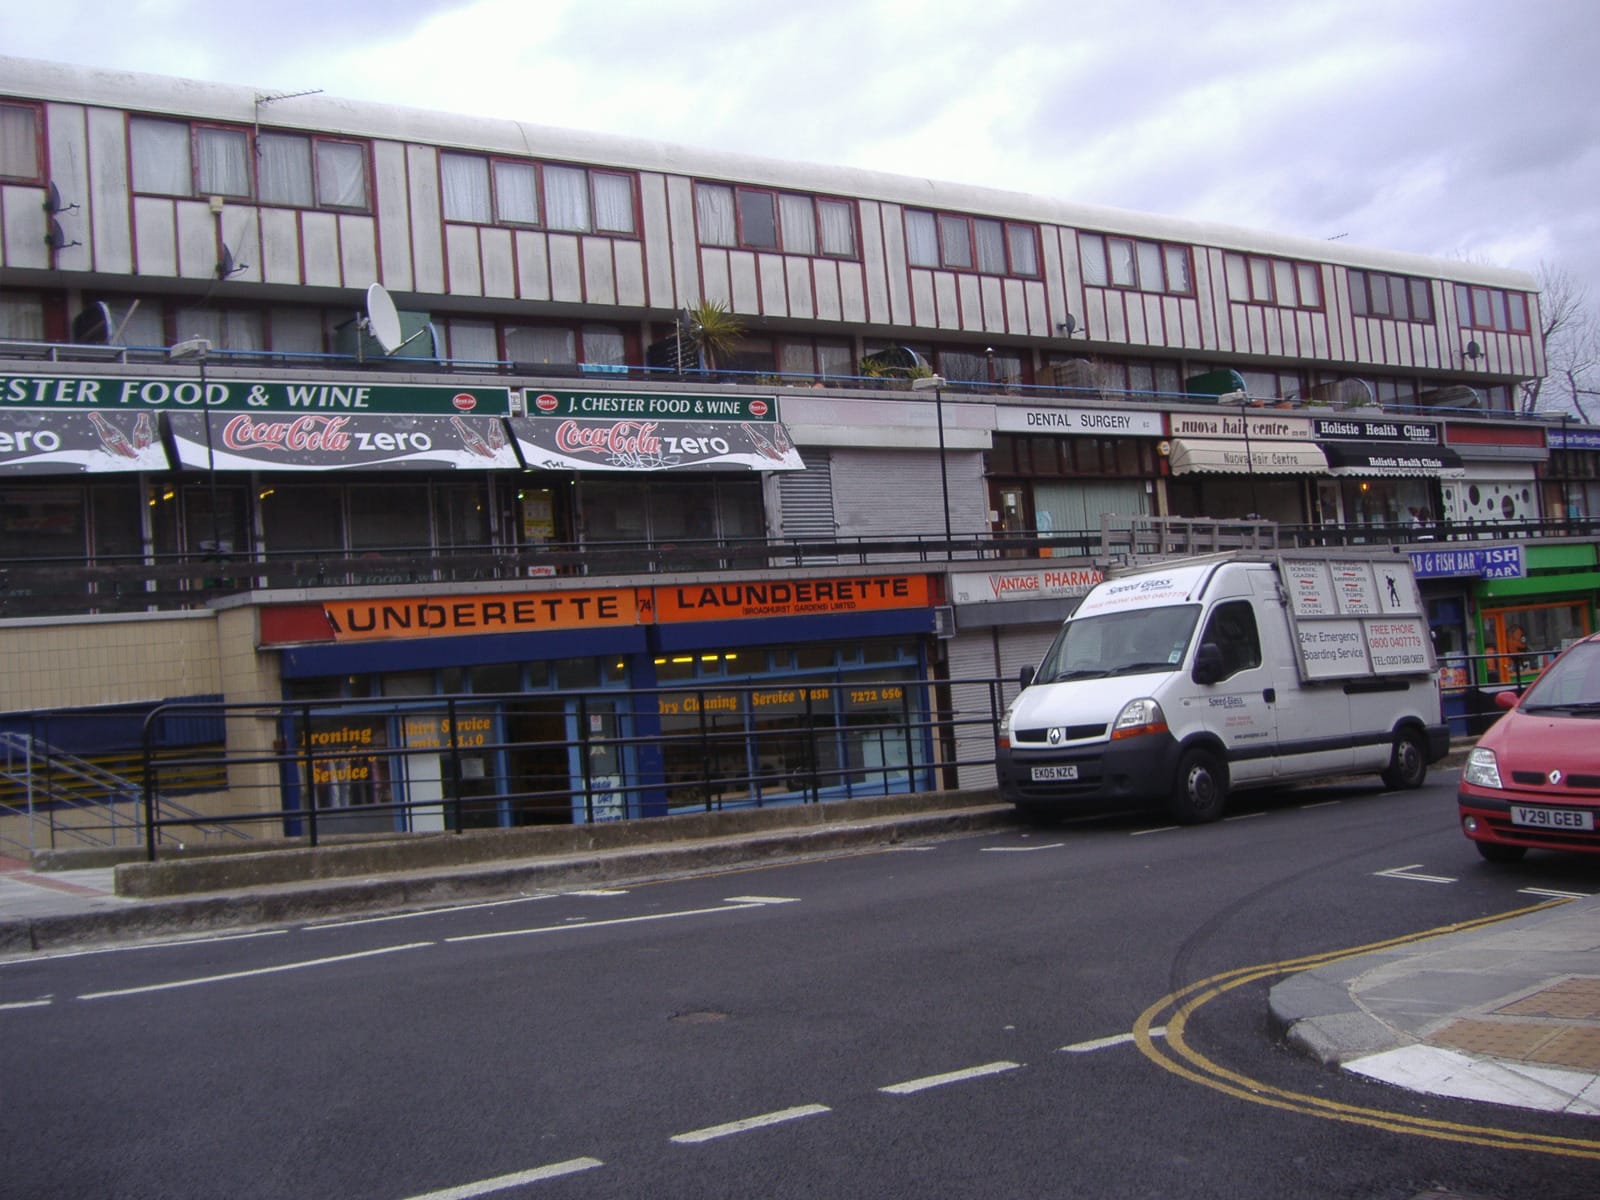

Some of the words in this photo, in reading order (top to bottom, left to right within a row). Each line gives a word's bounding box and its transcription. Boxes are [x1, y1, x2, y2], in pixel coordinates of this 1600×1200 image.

[120, 380, 229, 405] FOOD
[247, 384, 269, 406] &
[287, 386, 371, 408] WINE
[567, 397, 578, 413] J.
[581, 397, 645, 412] CHESTER
[648, 398, 691, 414] FOOD
[694, 400, 704, 414] &
[706, 401, 741, 414] WINE
[1026, 412, 1072, 427] DENTAL
[1080, 414, 1131, 428] SURGERY
[222, 414, 352, 453] Coca-Cola
[354, 430, 432, 451] zero
[1252, 422, 1289, 435] centre
[1320, 421, 1360, 436] Holistic
[1366, 423, 1398, 437] Health
[1403, 424, 1432, 438] Clinic
[555, 419, 662, 454] Coca-Cola
[663, 435, 730, 455] zero
[1223, 452, 1249, 465] Nuova
[1251, 453, 1269, 465] Hair
[1271, 453, 1299, 466] Centre
[1368, 457, 1397, 468] Holistic
[1397, 457, 1422, 467] Health
[1421, 458, 1442, 467] Clinic
[1425, 554, 1433, 571] &
[1435, 552, 1456, 571] FISH
[1457, 551, 1475, 569] BAR
[1485, 549, 1518, 563] ISH
[1486, 567, 1512, 577] BAR
[677, 577, 909, 609] LAUNDERETTE
[989, 574, 1039, 598] VANTAGE
[1370, 624, 1389, 635] FREE
[1391, 624, 1415, 634] PHONE
[1300, 632, 1317, 643] 24hr
[1320, 632, 1359, 644] Emergency
[1370, 636, 1389, 649] 0800
[1303, 649, 1337, 661] Boarding
[1338, 648, 1364, 659] Service
[752, 690, 794, 706] Service
[400, 720, 435, 735] hirt
[441, 717, 491, 734] Srvice
[313, 765, 369, 784] Service
[1034, 767, 1055, 779] EK05
[1056, 767, 1074, 778] NZC
[1519, 809, 1550, 824] V291
[1553, 811, 1583, 827] GEB
